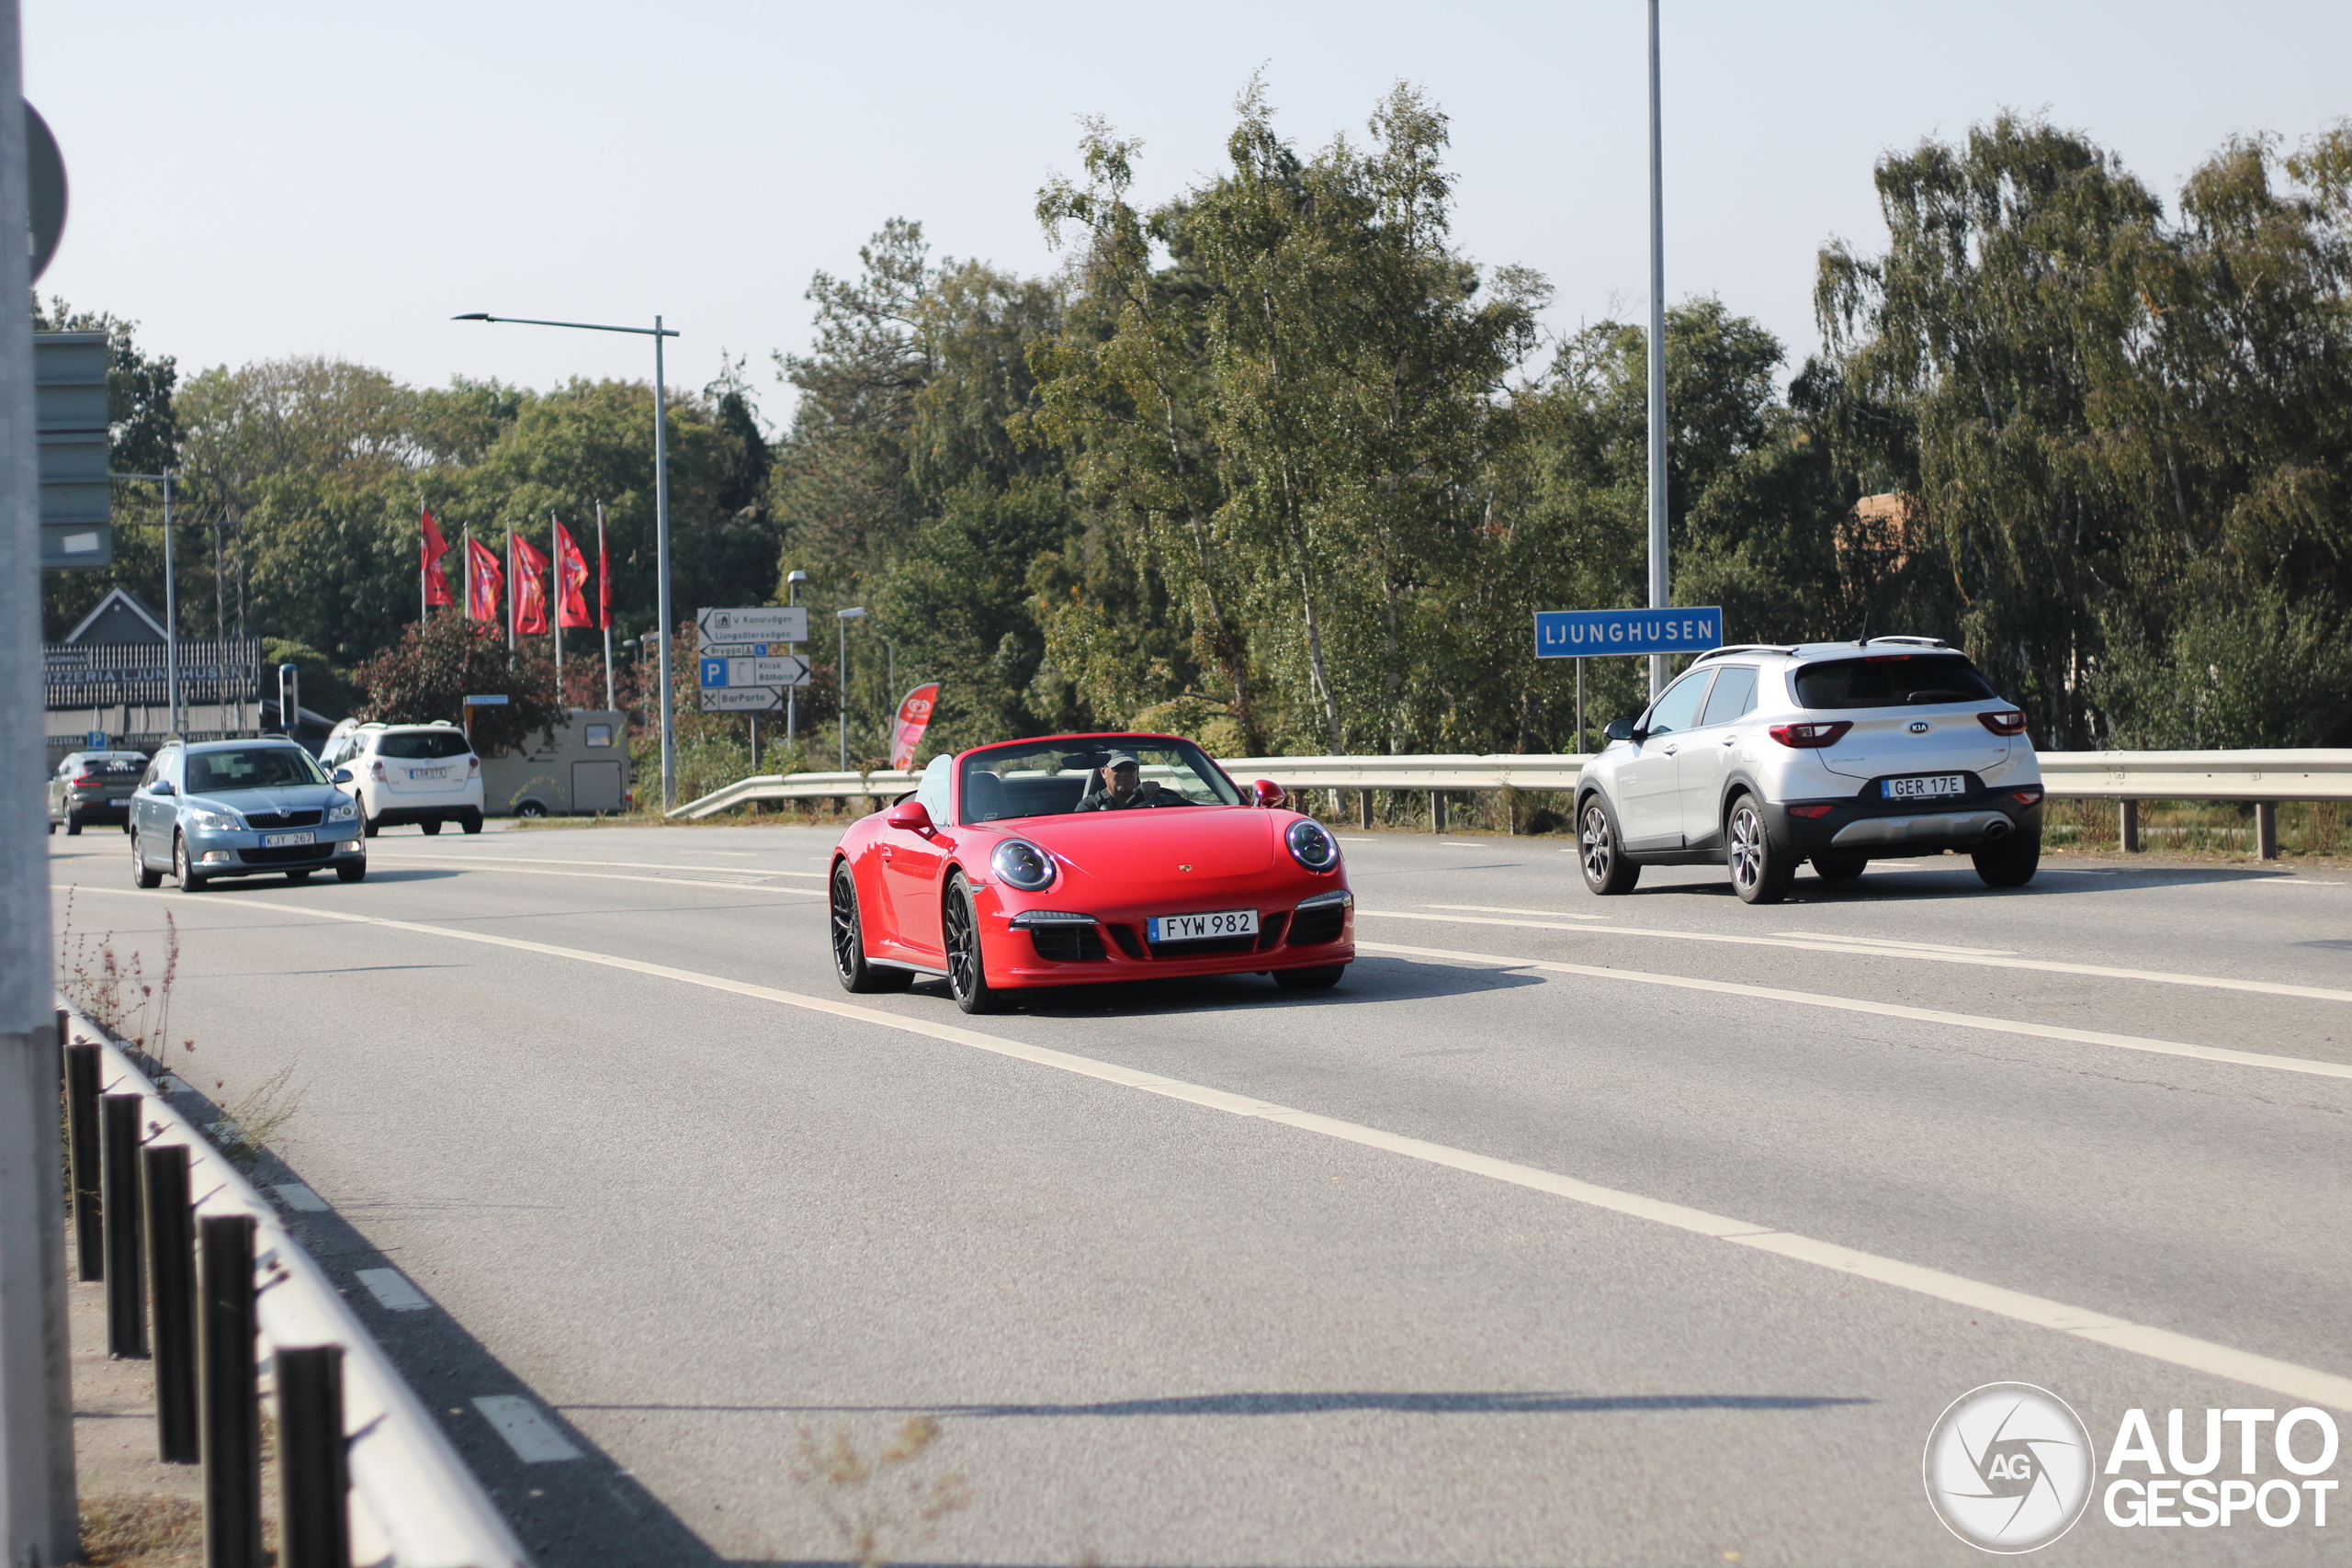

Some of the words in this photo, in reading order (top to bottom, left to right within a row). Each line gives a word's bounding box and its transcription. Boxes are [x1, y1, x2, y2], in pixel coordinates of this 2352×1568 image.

[743, 615, 793, 625] Kanalvägen
[715, 631, 791, 640] Ljungsätersvägen
[1545, 620, 1713, 644] LJUNGHUSEN
[710, 647, 741, 655] Brygga
[707, 663, 720, 682] P
[721, 694, 765, 703] BarPorto
[1894, 779, 1925, 795] GER
[1930, 777, 1958, 793] 17E
[266, 835, 286, 846] KJY
[294, 832, 311, 843] 267
[1167, 917, 1205, 937] FYW
[1211, 913, 1250, 934] 982
